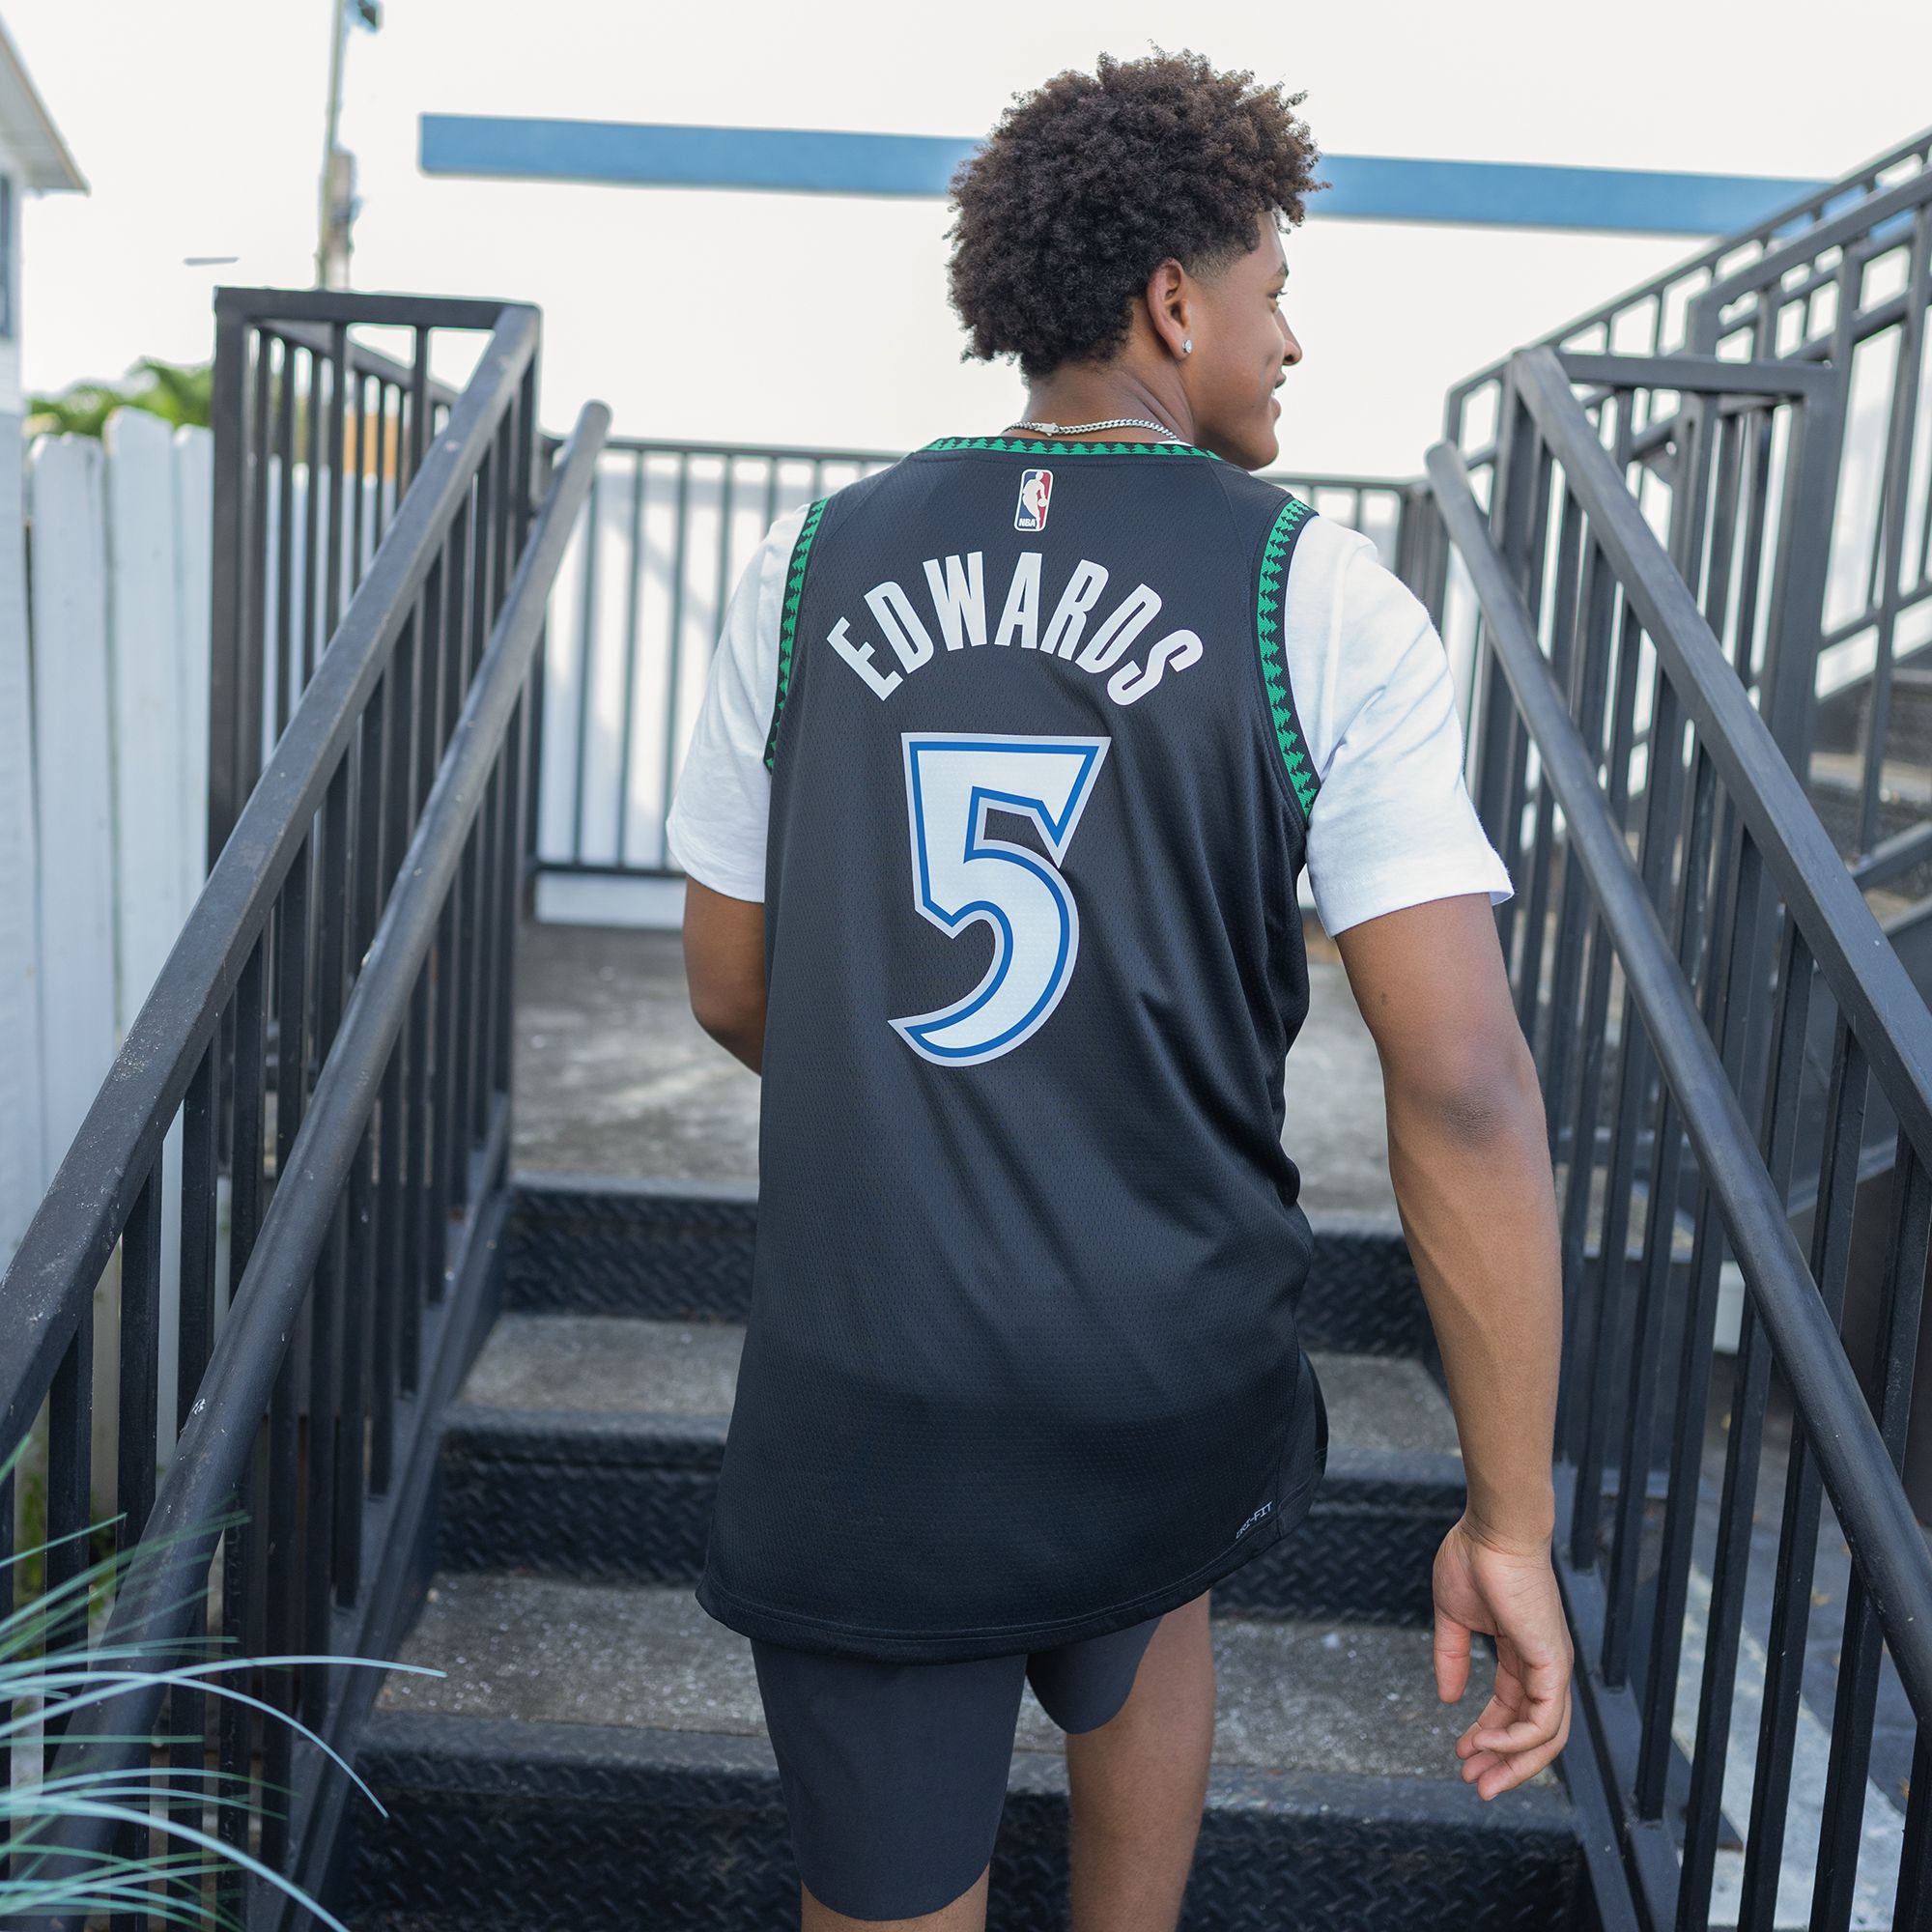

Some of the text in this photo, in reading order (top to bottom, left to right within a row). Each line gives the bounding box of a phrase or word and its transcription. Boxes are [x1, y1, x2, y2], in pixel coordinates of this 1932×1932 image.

[1018, 518, 1036, 526] NBA
[826, 551, 1204, 705] EDWARDS
[887, 732, 1112, 1066] 5
